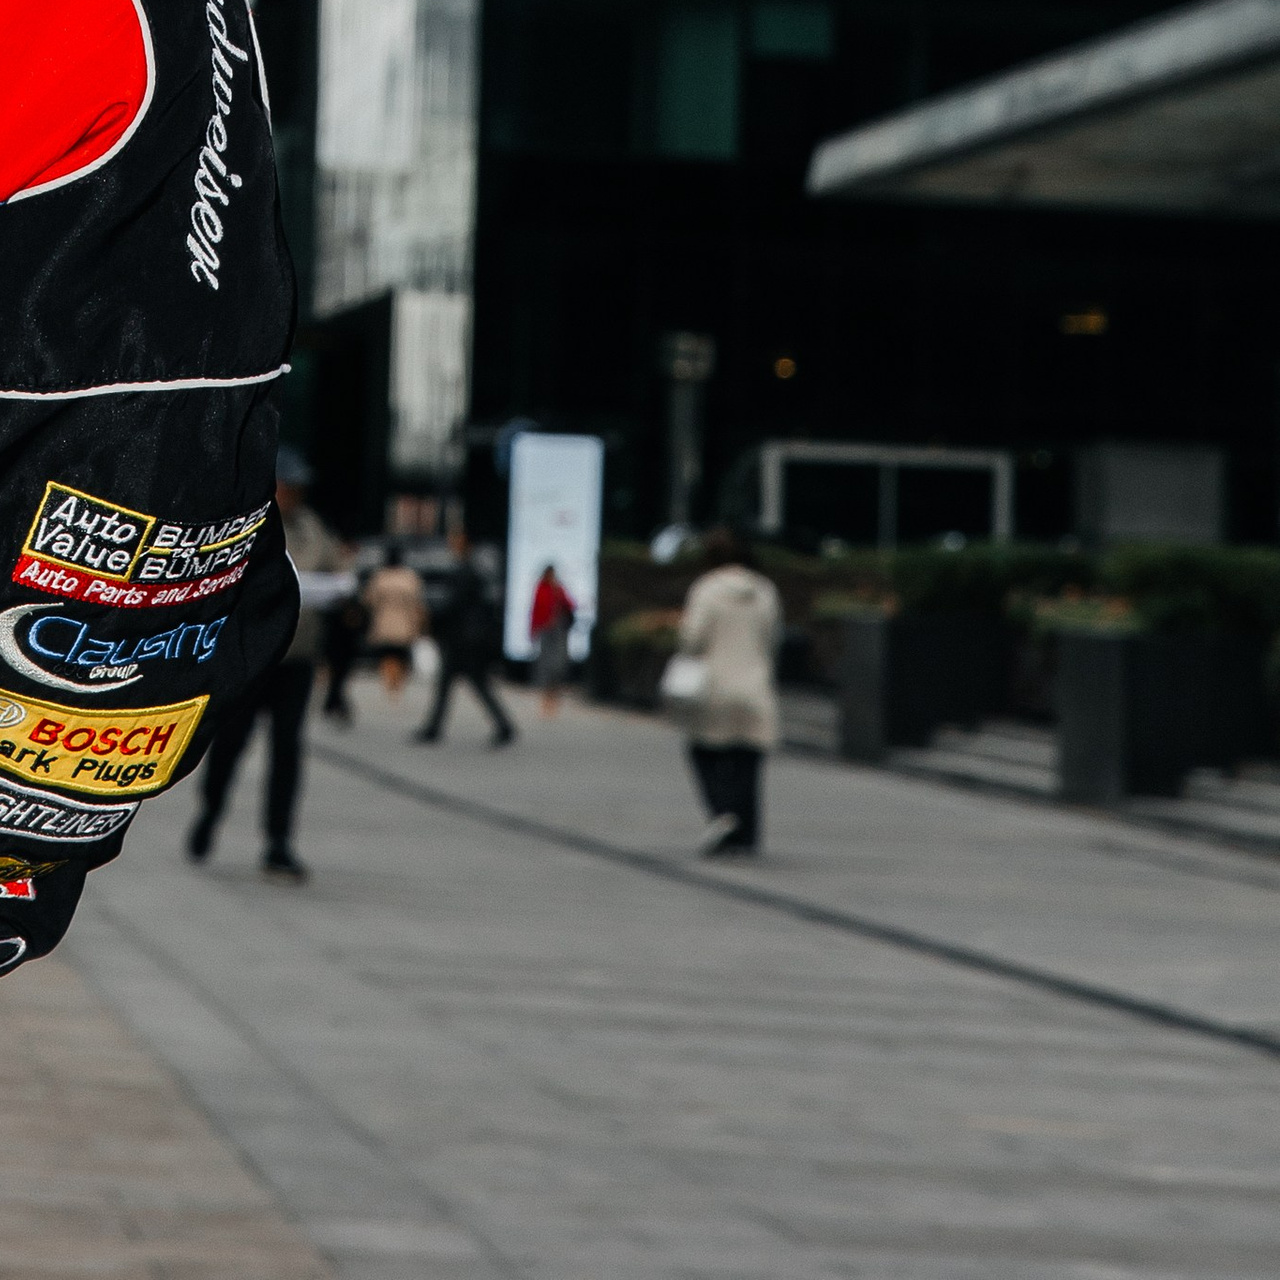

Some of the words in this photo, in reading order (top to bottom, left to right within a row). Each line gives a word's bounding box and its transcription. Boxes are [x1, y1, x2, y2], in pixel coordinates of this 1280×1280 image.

[50, 496, 138, 544] Auto
[153, 501, 271, 548] BUMPER
[33, 518, 131, 572] Value
[140, 532, 257, 579] BUMPER
[19, 561, 79, 592] Auto
[84, 579, 147, 605] Parts
[151, 583, 194, 605] and
[28, 615, 228, 665] Clausing
[28, 718, 178, 756] BOSCH
[71, 758, 158, 787] Plugs
